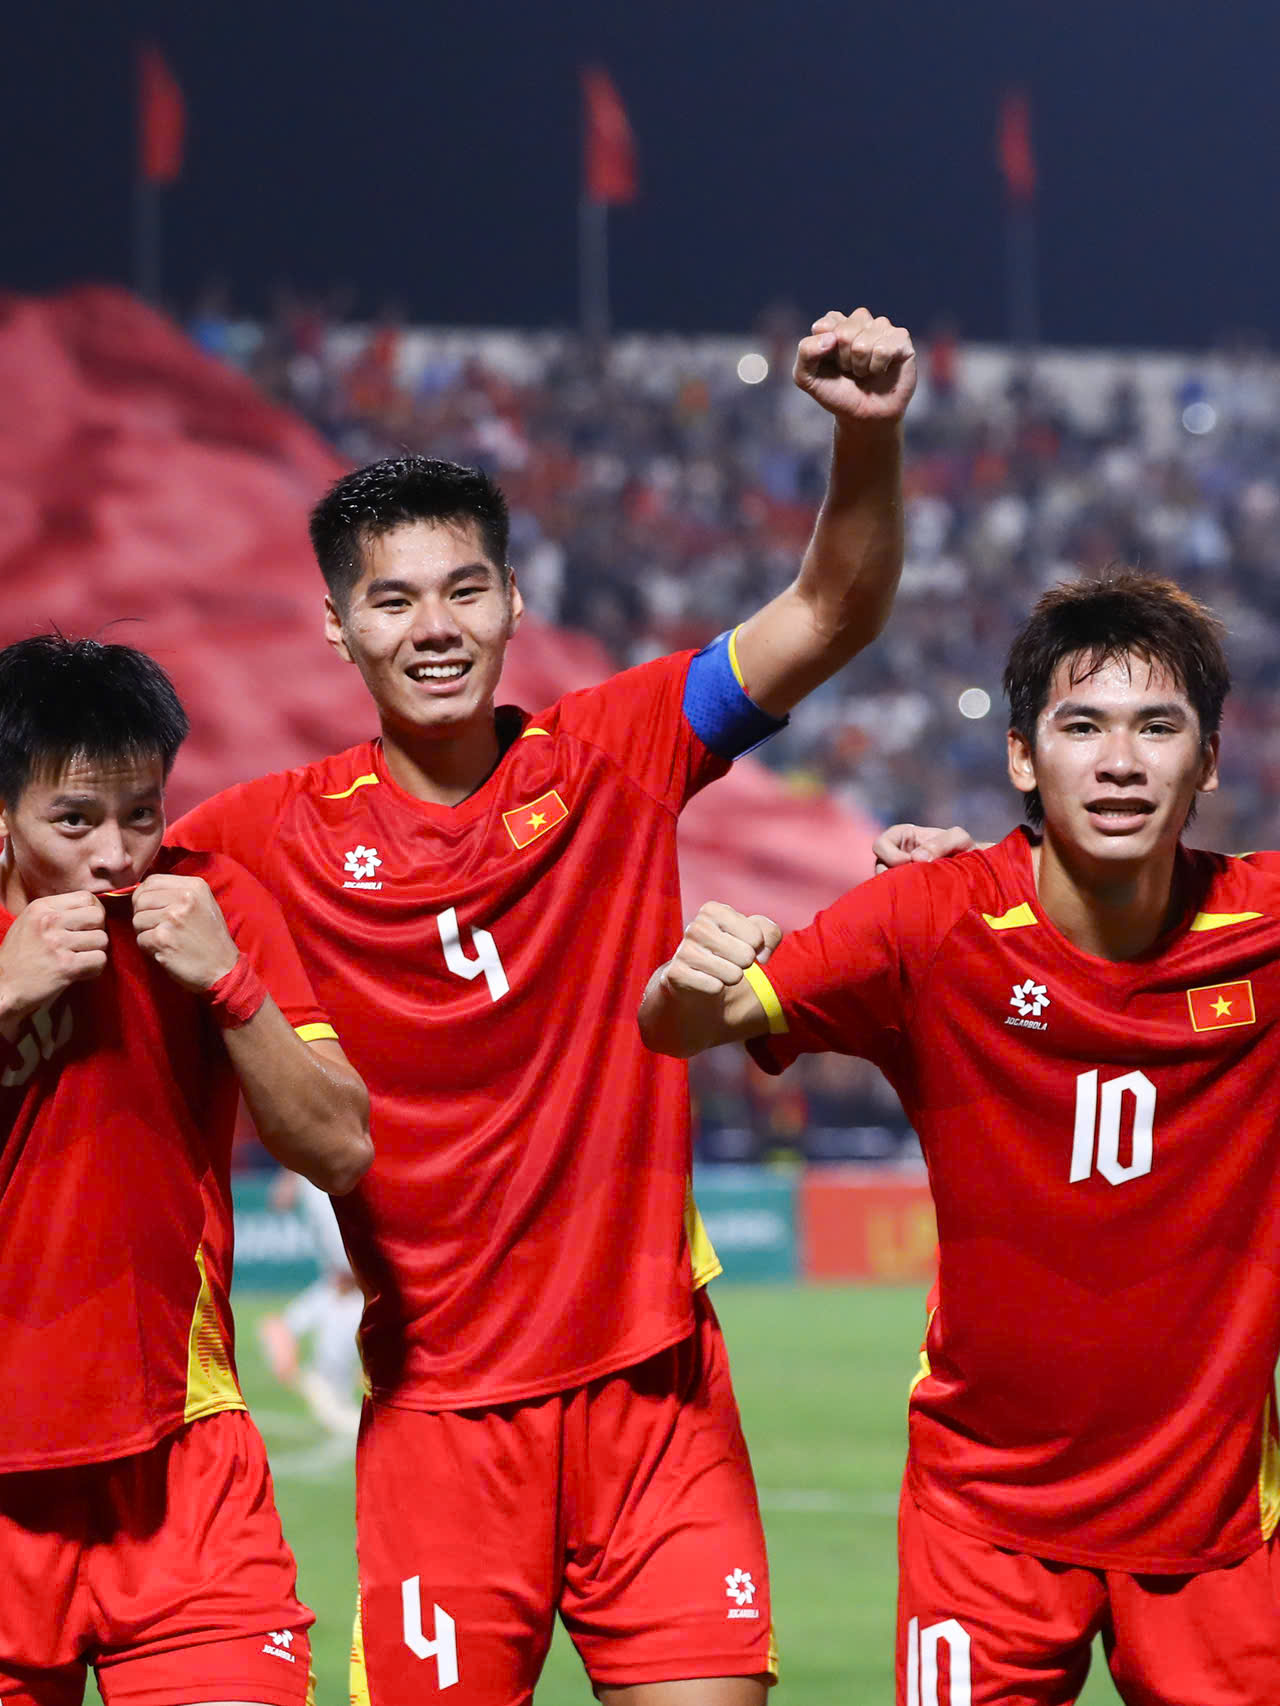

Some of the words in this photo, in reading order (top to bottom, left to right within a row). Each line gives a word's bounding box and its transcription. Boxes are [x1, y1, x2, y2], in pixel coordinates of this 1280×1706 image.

[436, 906, 511, 1003] 4
[1069, 1068, 1157, 1186] 10
[401, 1574, 460, 1690] 4
[907, 1616, 972, 1706] 10
